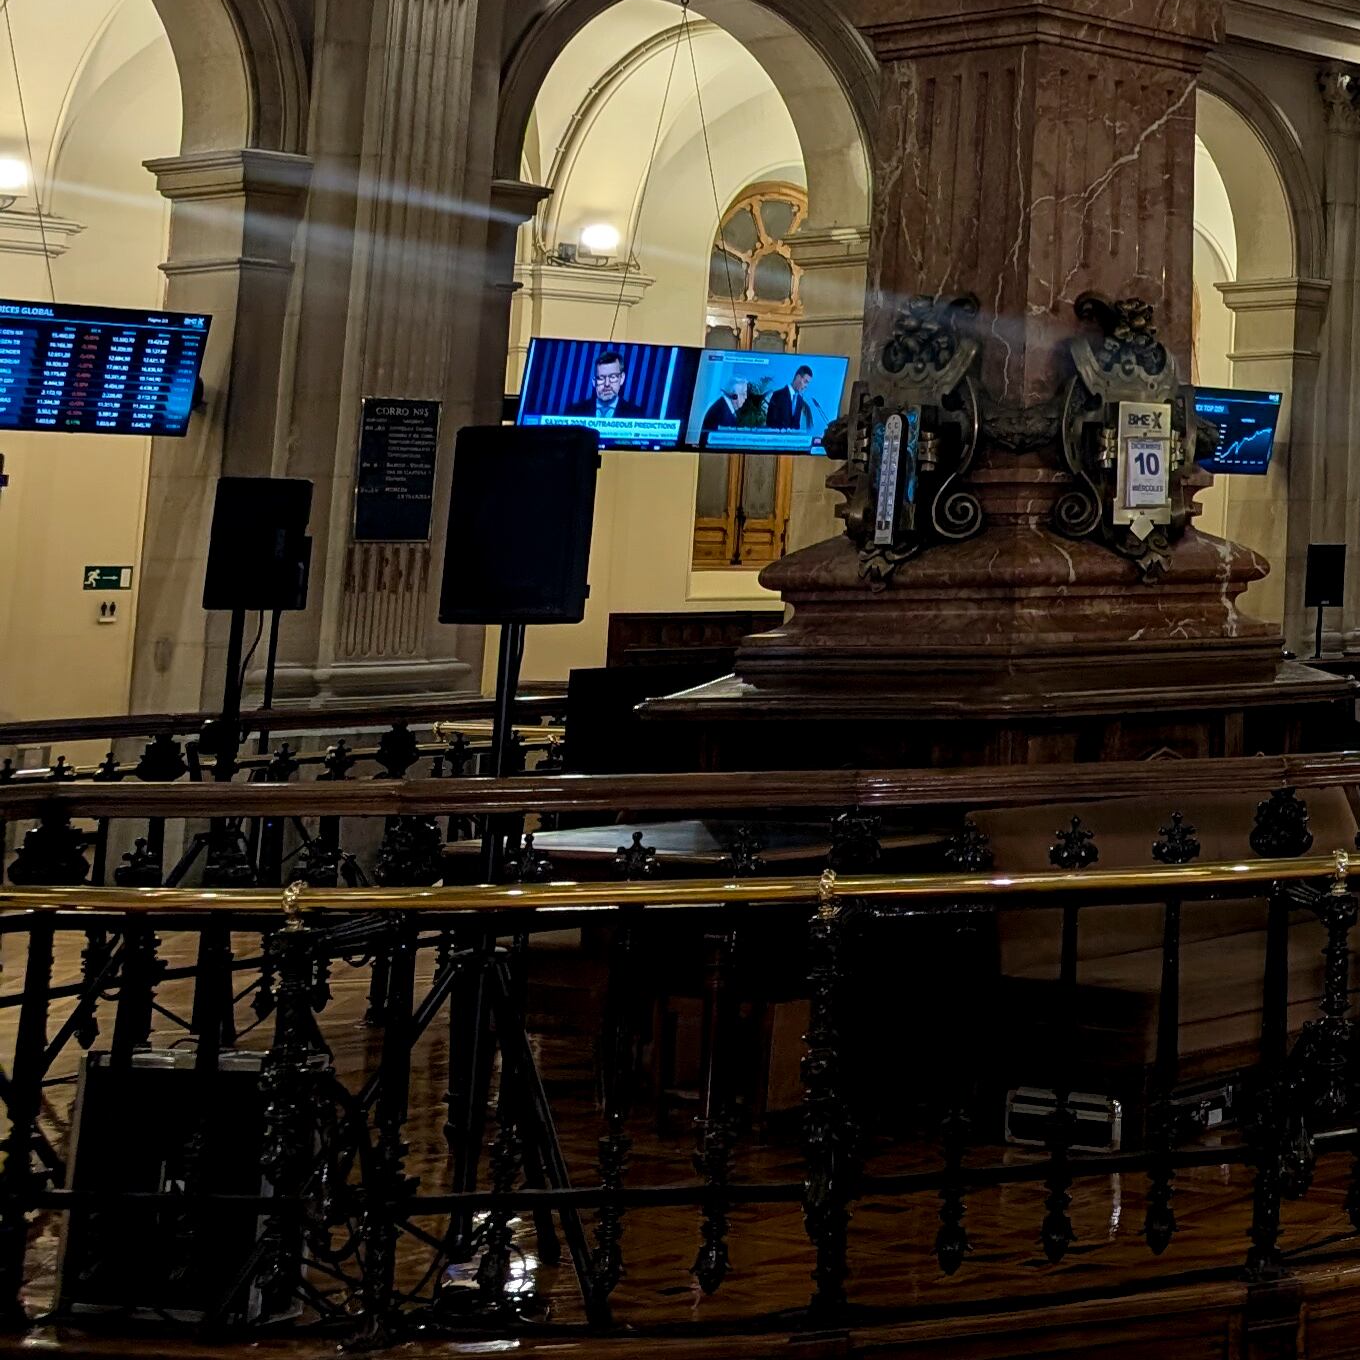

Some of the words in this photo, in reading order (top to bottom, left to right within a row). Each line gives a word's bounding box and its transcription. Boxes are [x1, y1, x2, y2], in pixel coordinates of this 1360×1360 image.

[21, 307, 54, 317] GLOBAL
[375, 407, 410, 417] CORRO
[1128, 413, 1151, 426] BME
[587, 420, 633, 429] OUTRAGEOUS
[634, 421, 677, 430] PREDICTIONS
[1135, 452, 1160, 476] 10
